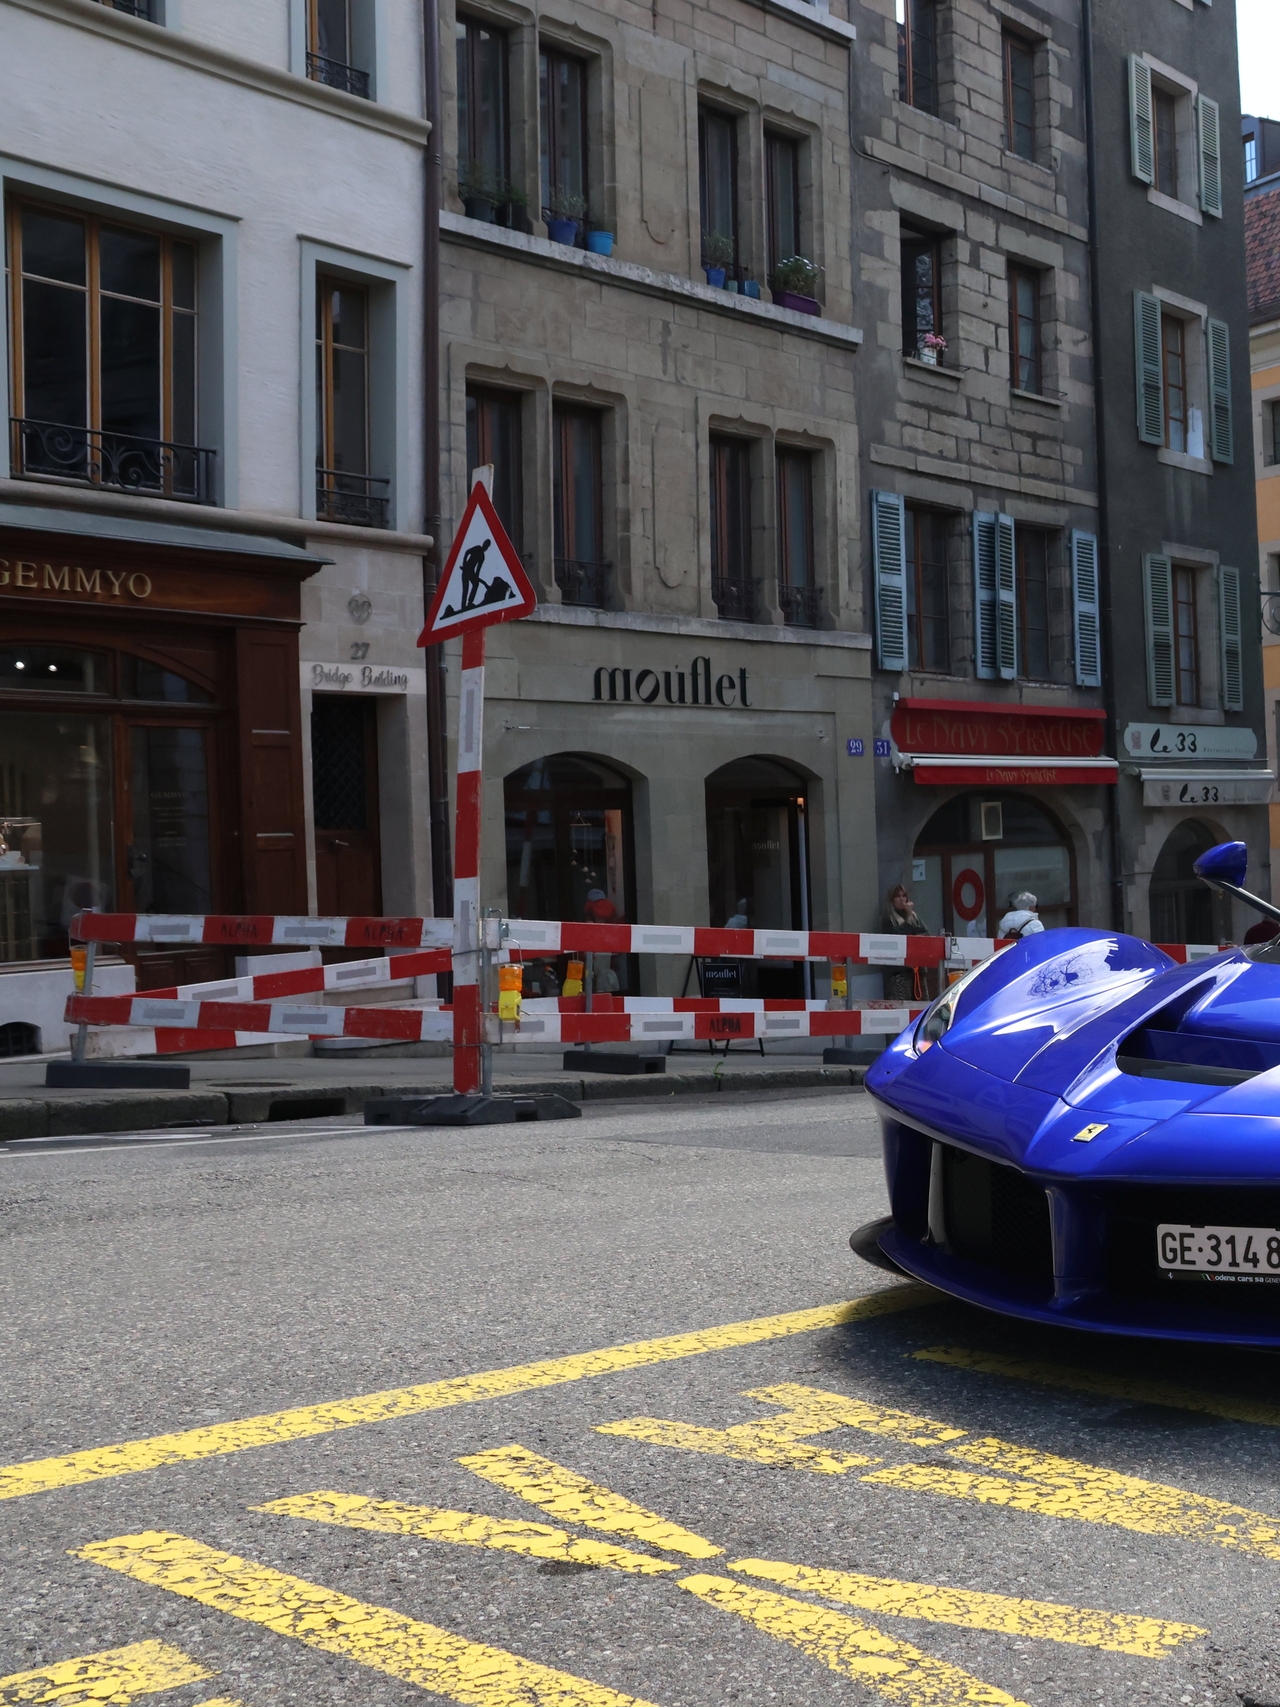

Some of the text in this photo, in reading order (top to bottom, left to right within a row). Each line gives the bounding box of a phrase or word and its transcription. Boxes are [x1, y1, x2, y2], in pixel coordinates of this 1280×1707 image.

[350, 641, 370, 660] 27
[312, 664, 409, 690] Bridge Building
[849, 740, 863, 754] 29
[876, 741, 889, 755] 31
[1175, 732, 1197, 753] 33
